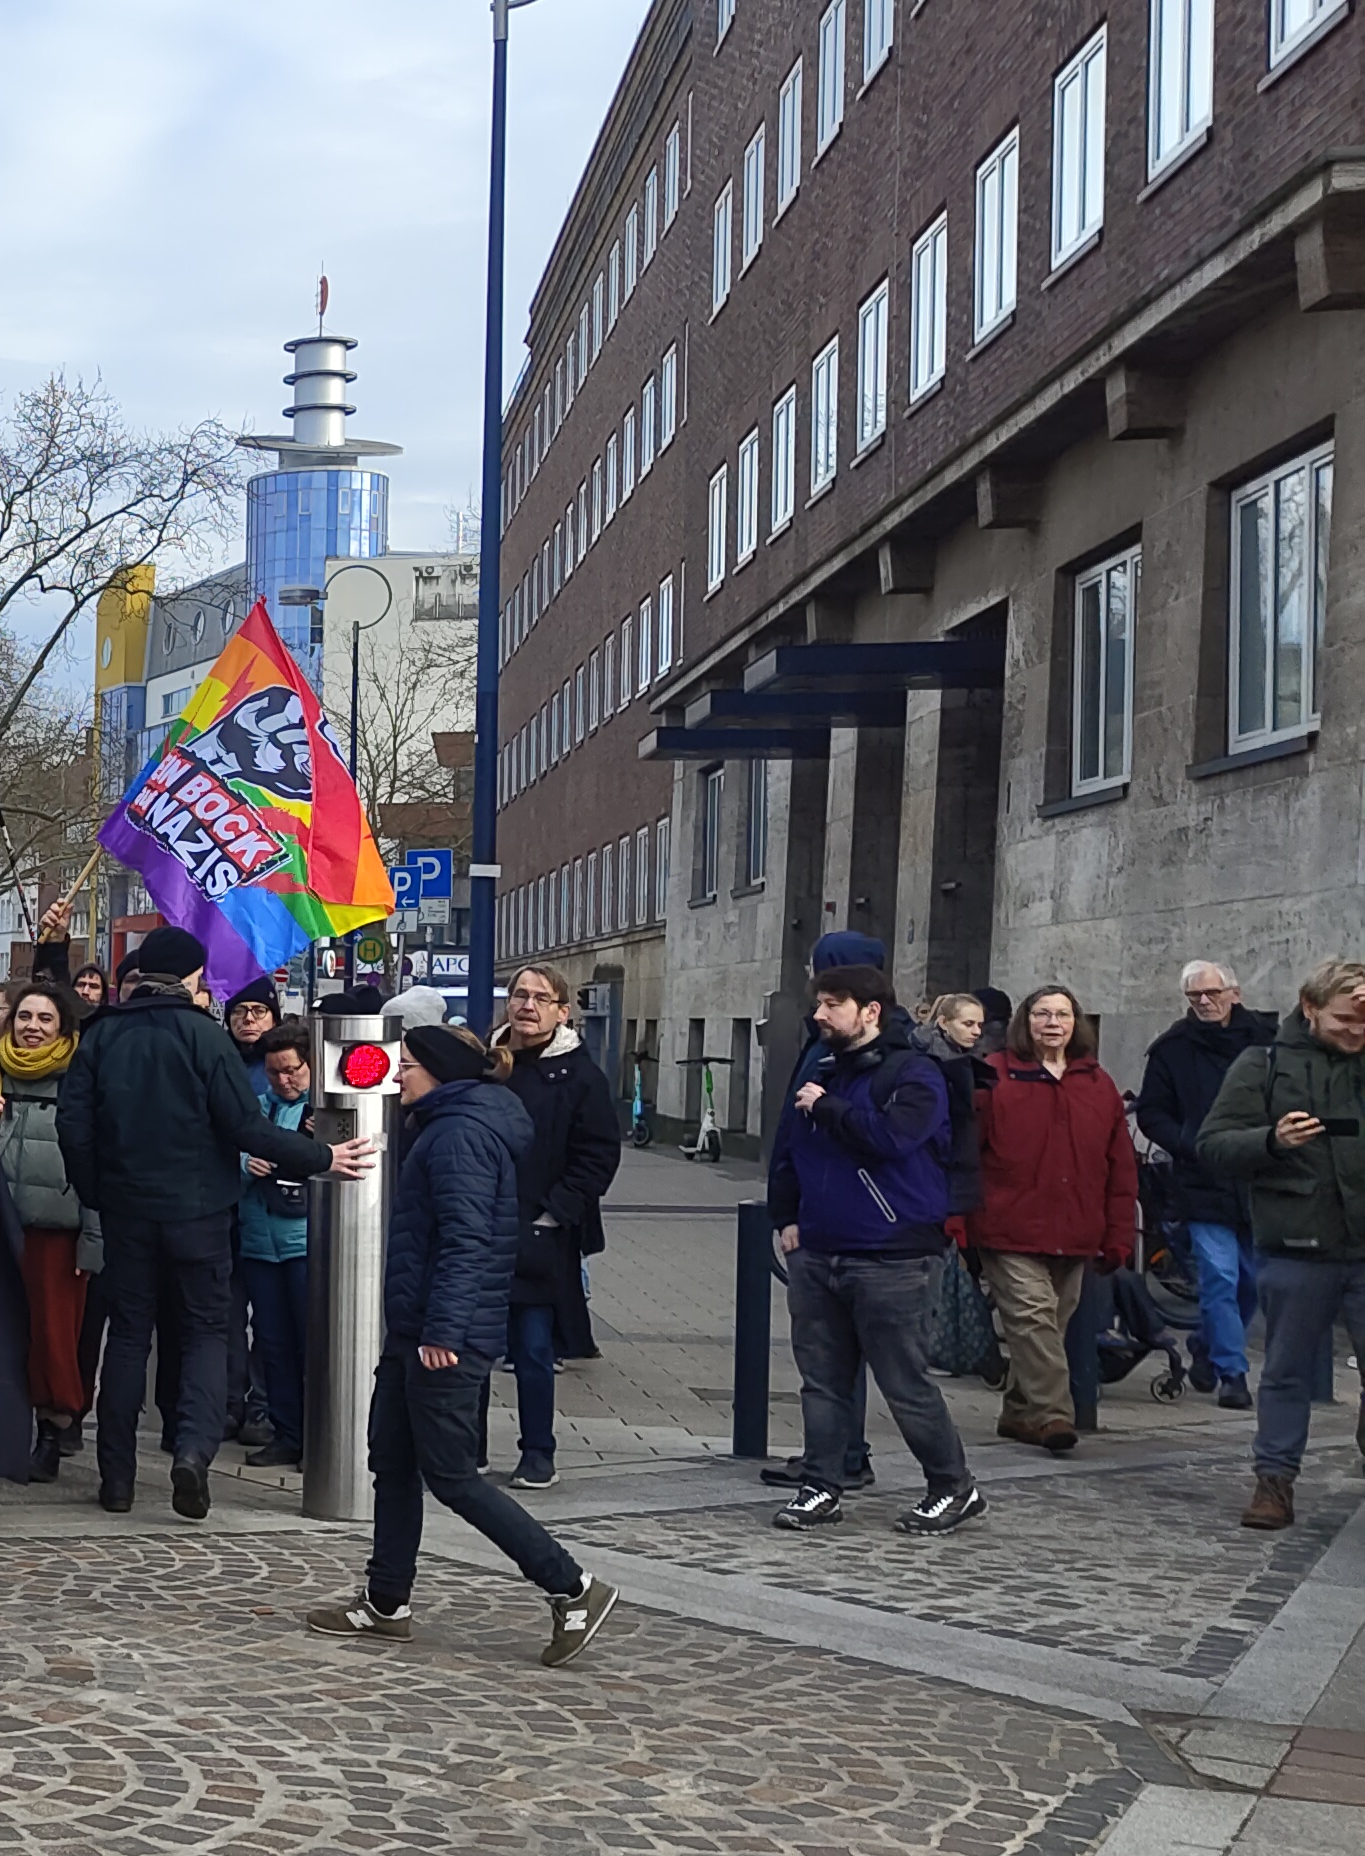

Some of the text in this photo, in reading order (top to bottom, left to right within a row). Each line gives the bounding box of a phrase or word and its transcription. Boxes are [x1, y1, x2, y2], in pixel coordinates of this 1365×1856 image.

[176, 774, 275, 868] BOCK
[145, 792, 239, 897] NAZIS
[417, 856, 441, 880] P
[394, 871, 412, 892] P
[363, 943, 376, 958] H
